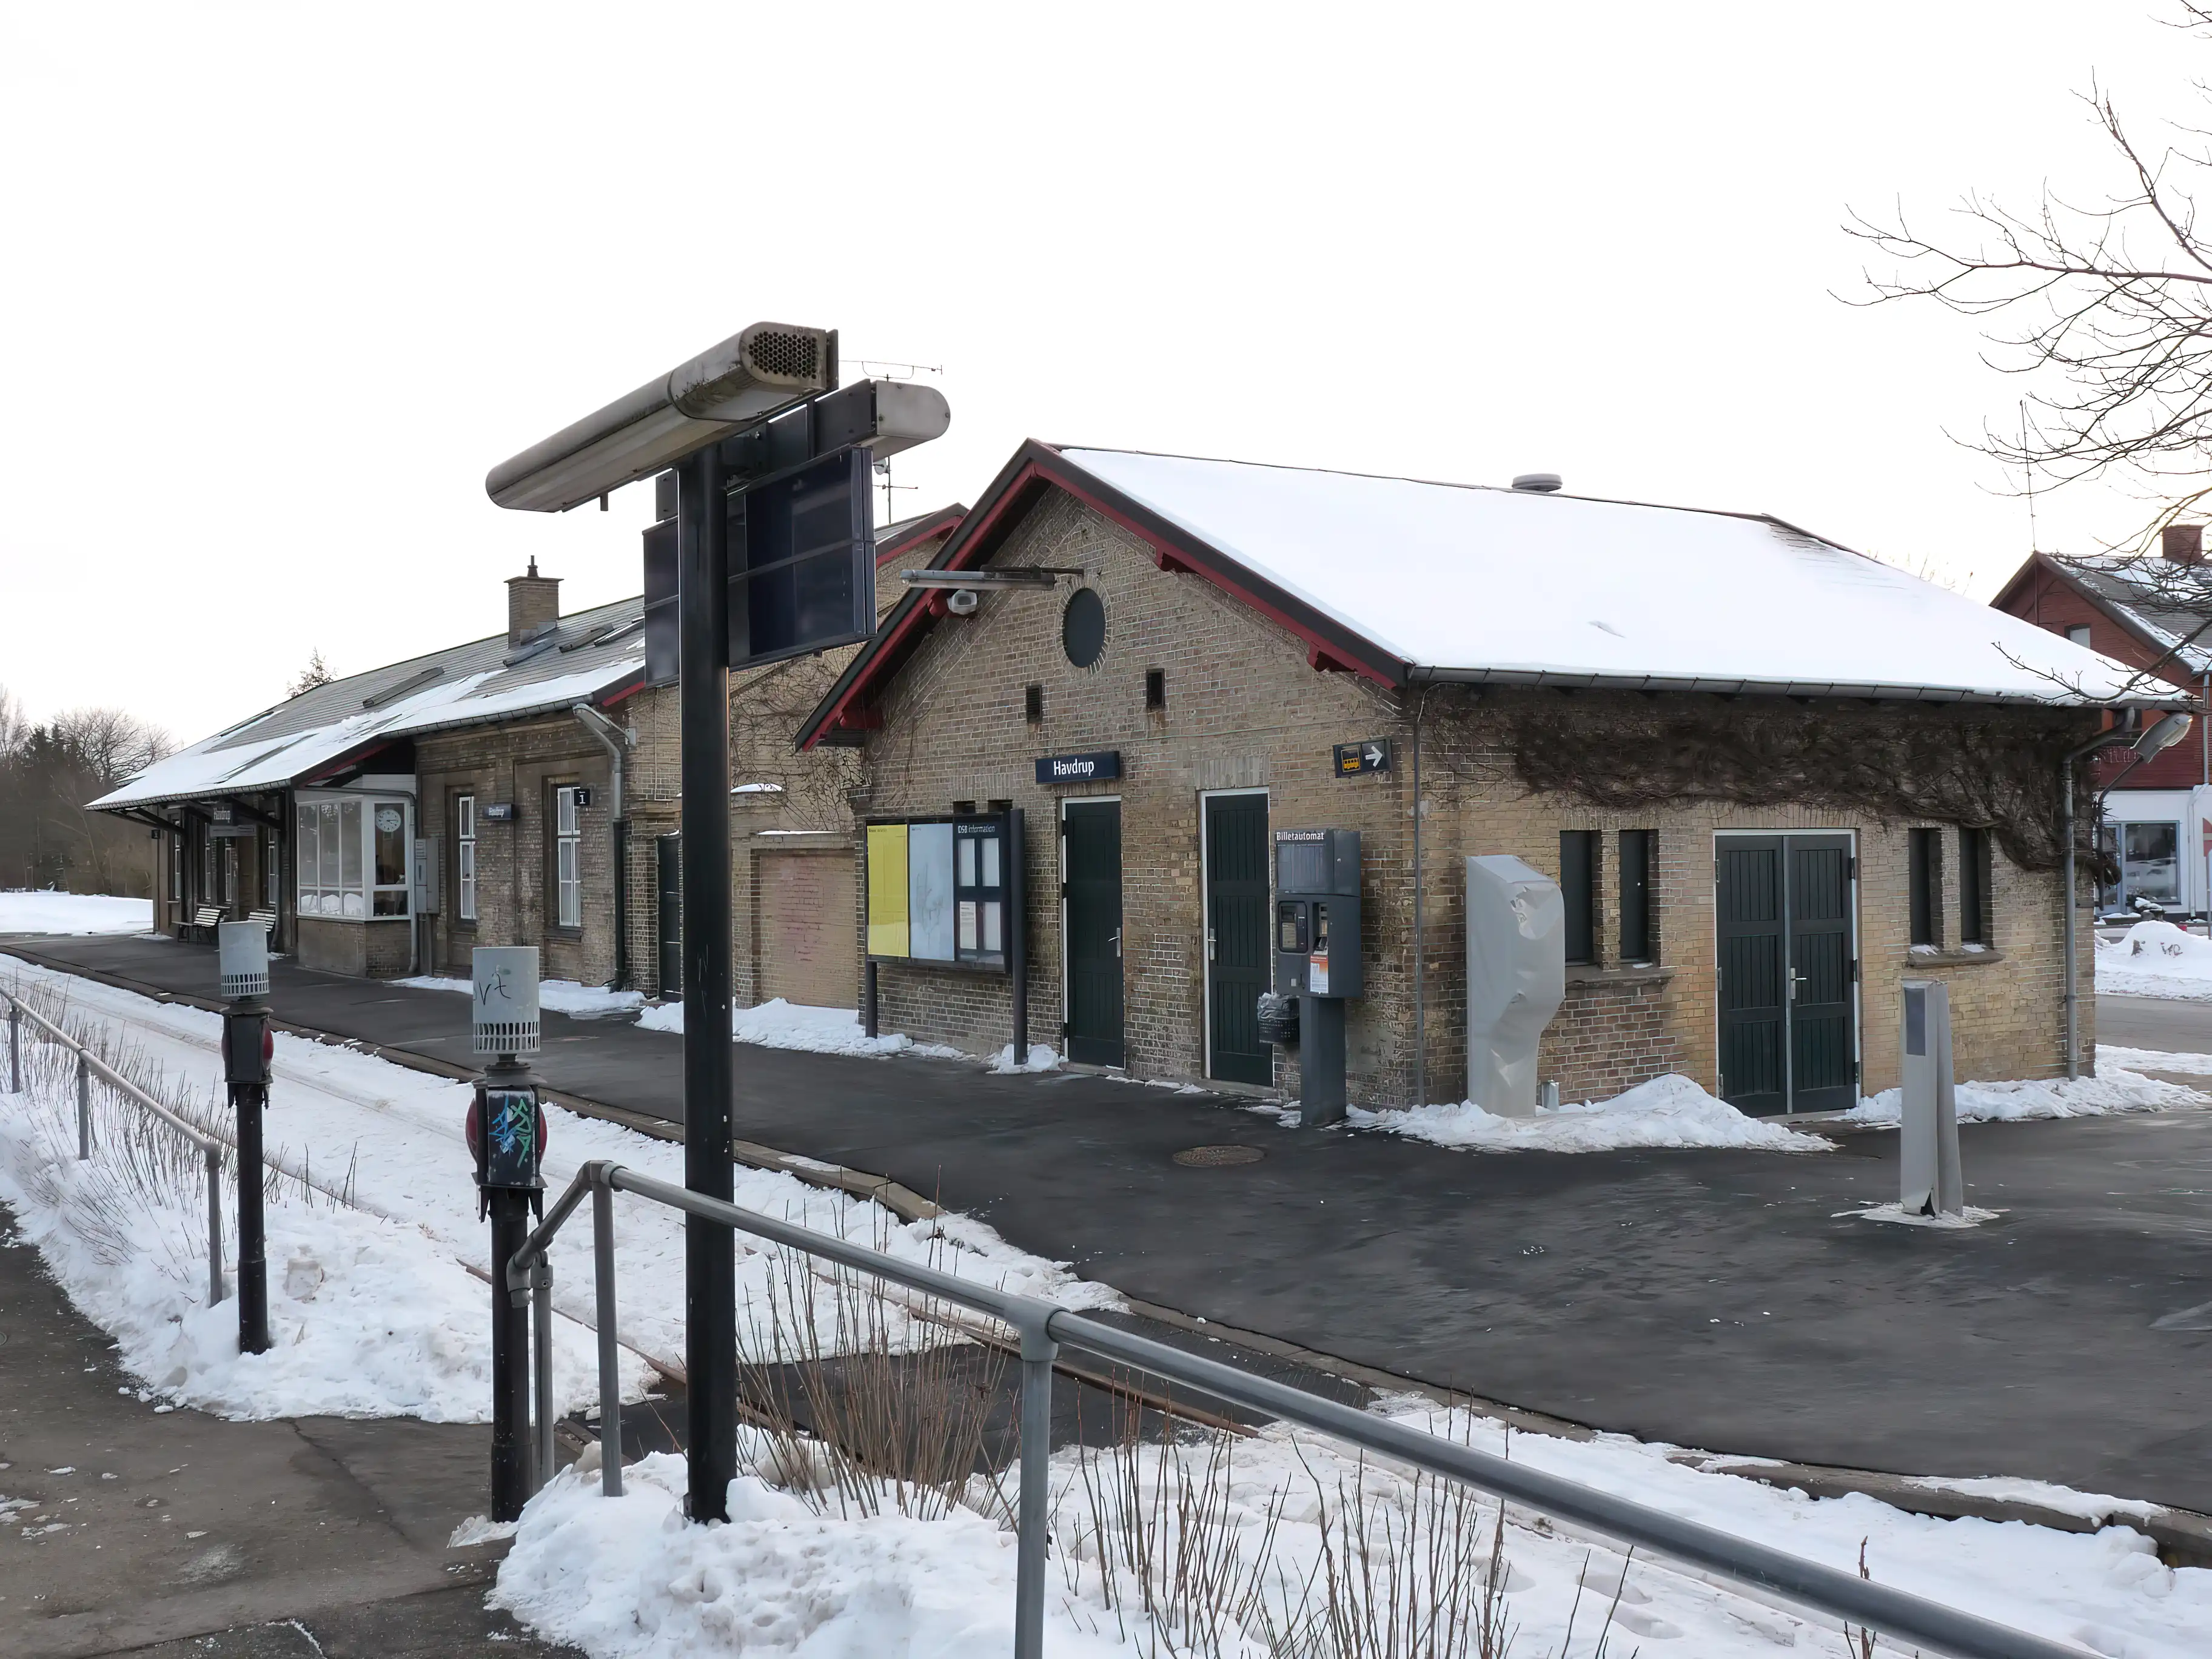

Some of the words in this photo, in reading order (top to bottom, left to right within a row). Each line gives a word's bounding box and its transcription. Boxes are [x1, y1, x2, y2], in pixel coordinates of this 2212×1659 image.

[1053, 758, 1094, 777] Havdrup
[579, 794, 586, 804] 1
[1276, 831, 1324, 841] Billetautomat
